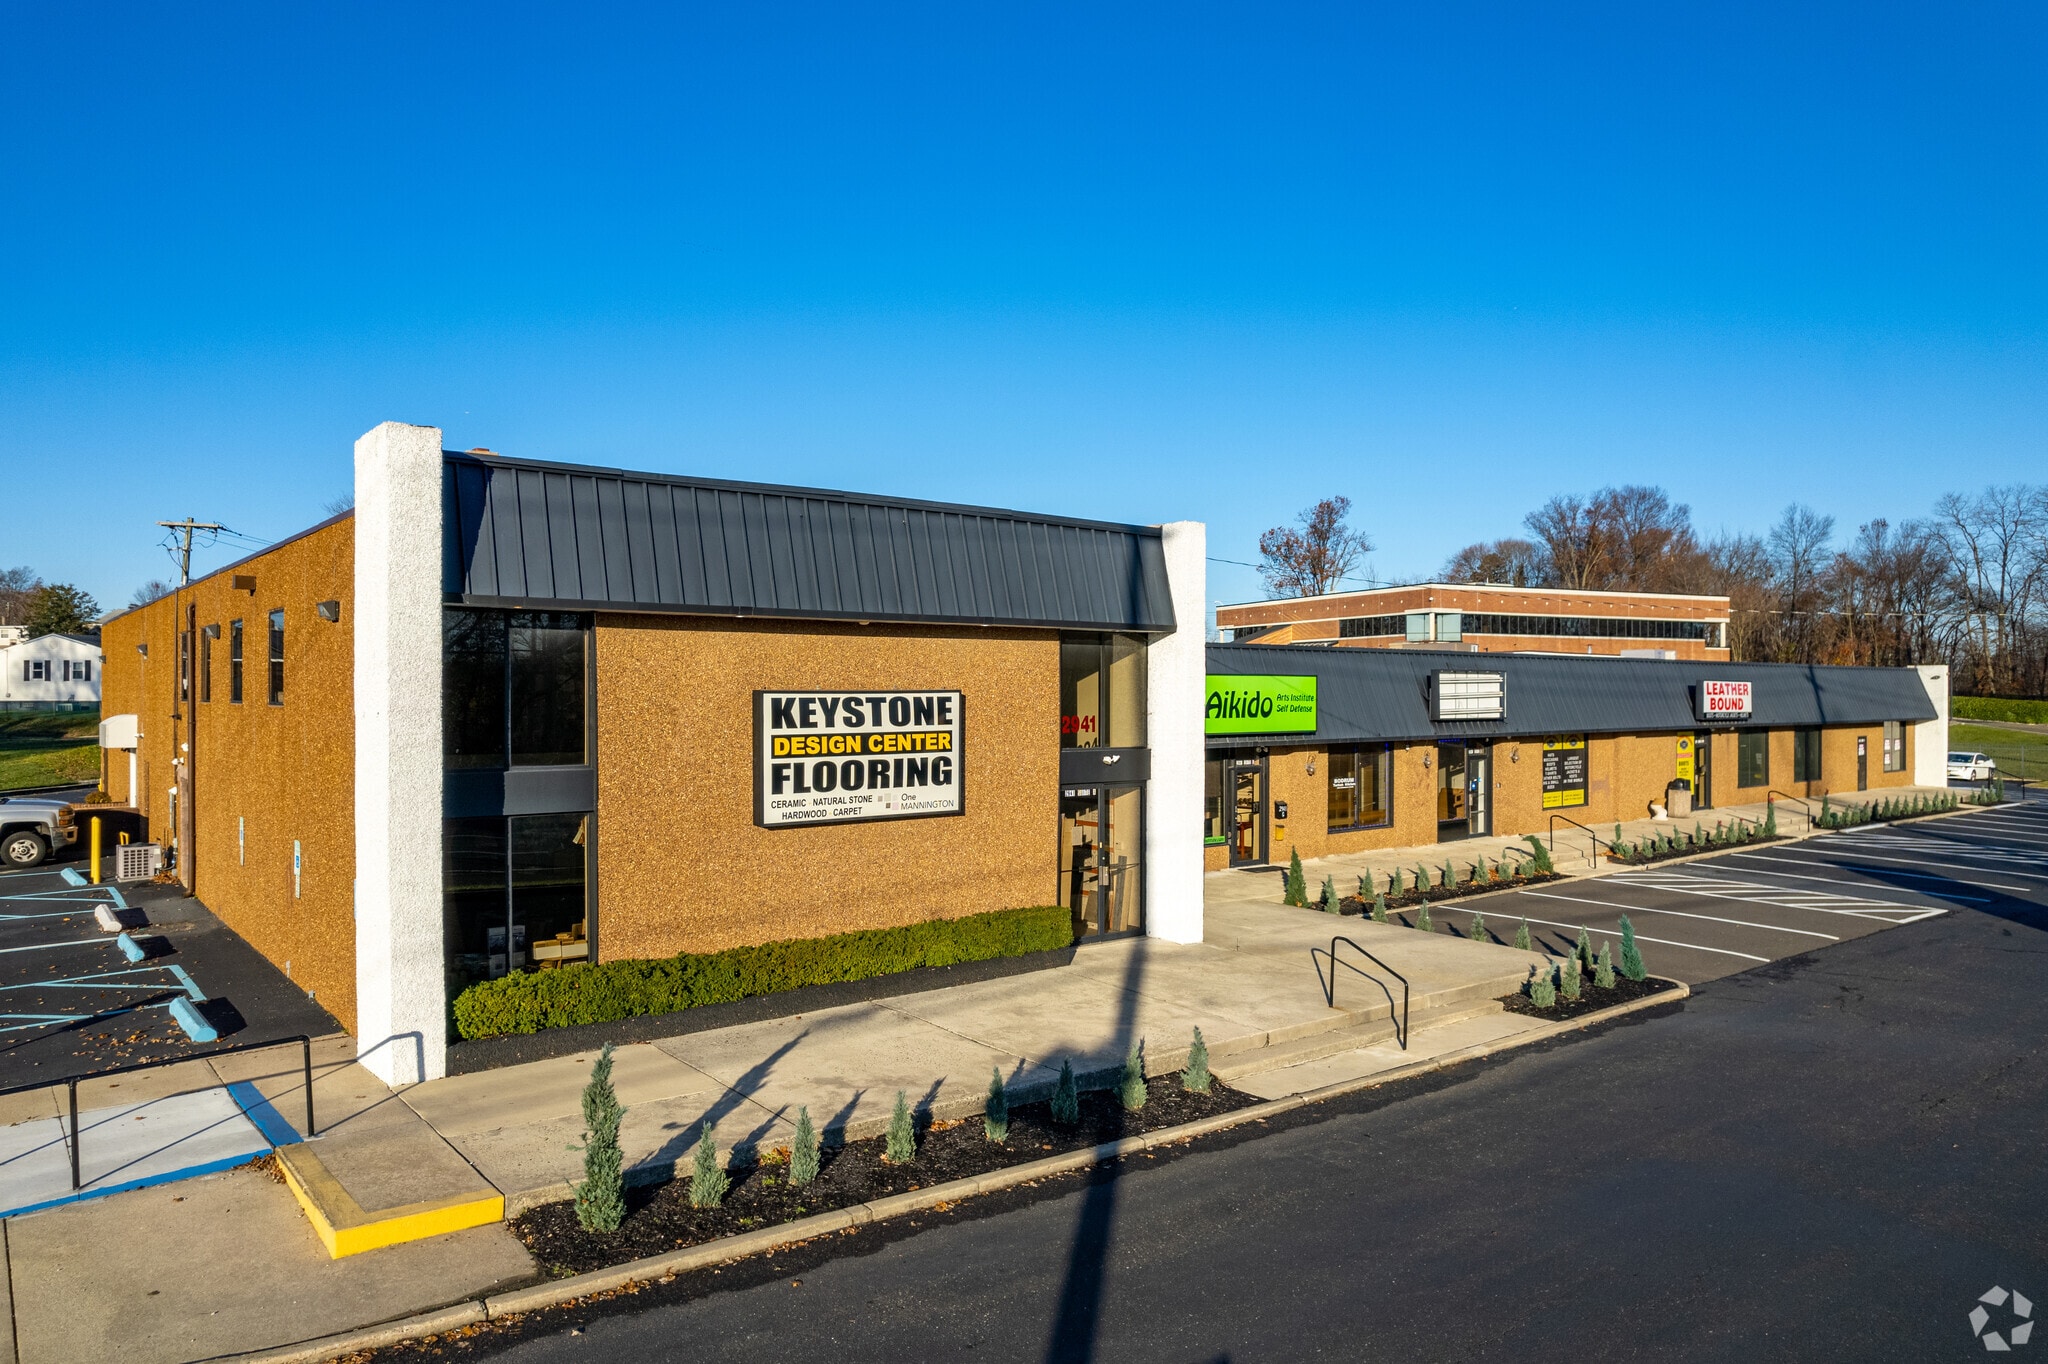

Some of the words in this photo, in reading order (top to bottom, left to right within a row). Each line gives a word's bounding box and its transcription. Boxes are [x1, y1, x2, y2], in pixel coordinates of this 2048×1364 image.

[1706, 682, 1749, 696] LEATHER
[1205, 691, 1273, 718] Aikido
[1276, 693, 1289, 701] Arts
[1290, 693, 1315, 702] Institute
[1710, 697, 1744, 711] BOUND
[771, 696, 953, 730] KEYSTONE
[1276, 704, 1289, 713] Self
[1290, 704, 1313, 713] Defense
[1061, 715, 1096, 734] 2941
[774, 735, 861, 756] DESIGN
[868, 732, 951, 752] CENTER
[771, 756, 953, 795] FLOORING
[771, 799, 806, 809] CERAMIC
[813, 796, 847, 807] NATURAL
[848, 794, 873, 804] STONE
[901, 793, 917, 801] One
[901, 800, 954, 810] MANNINGTON
[782, 809, 827, 820] HARDWOOD
[833, 807, 863, 816] CARPET
